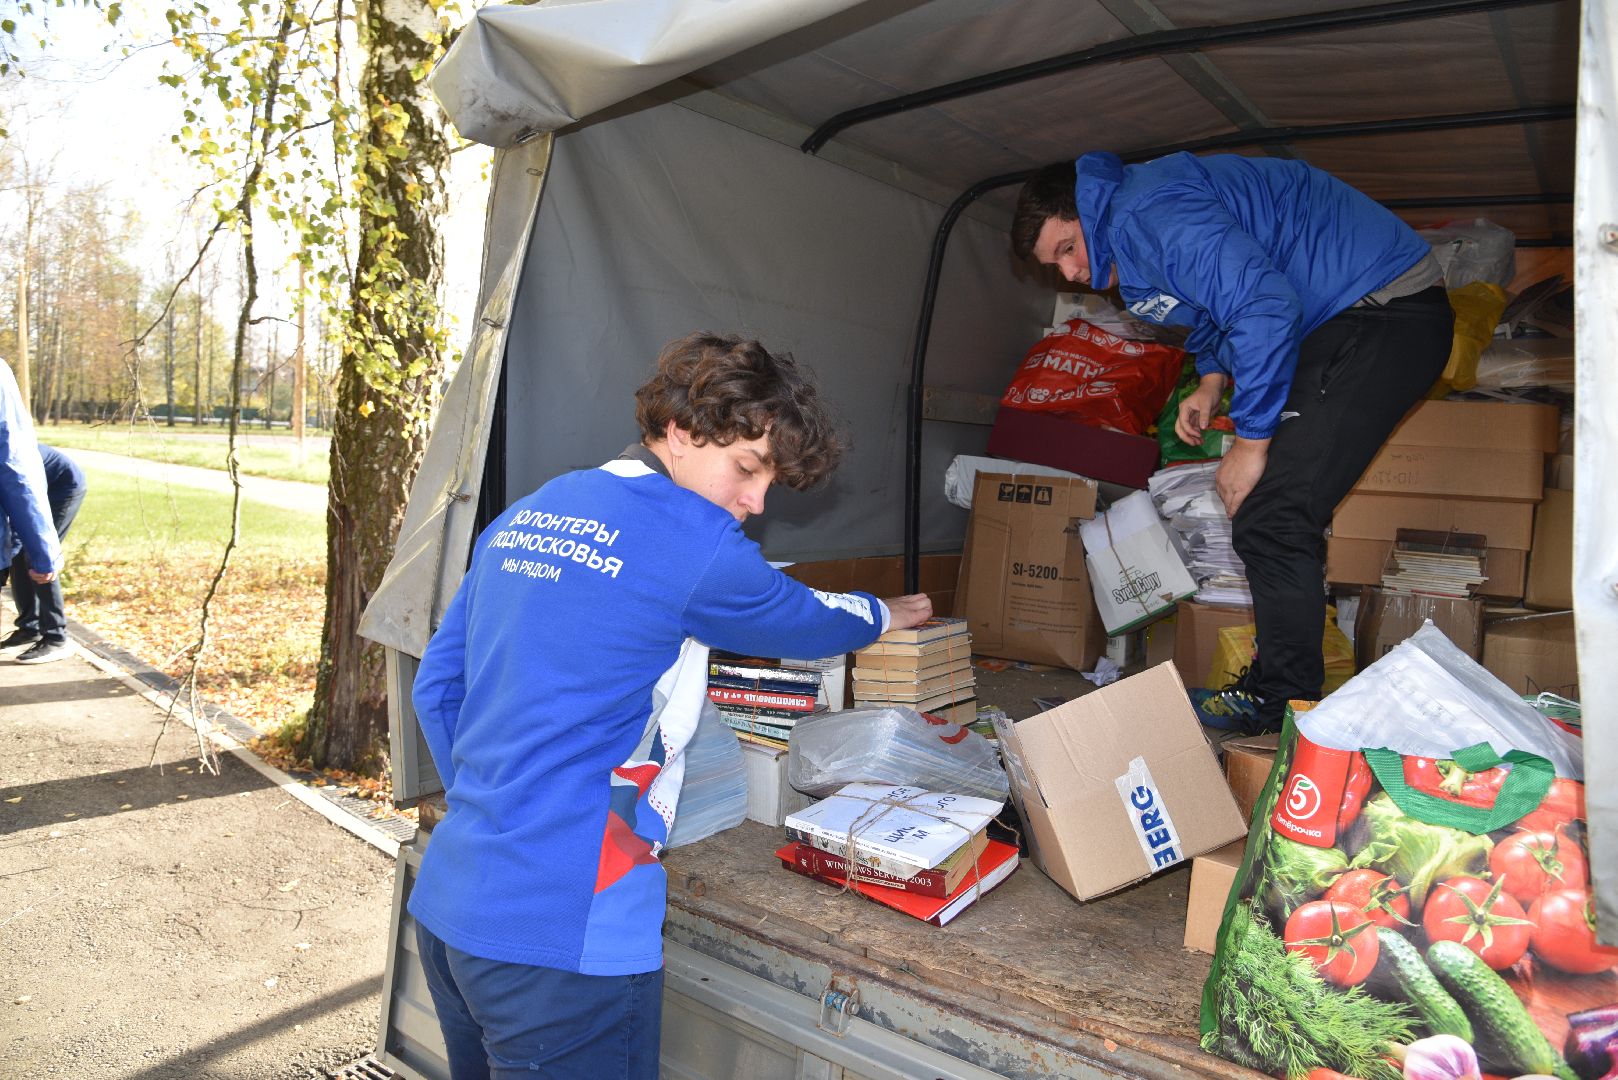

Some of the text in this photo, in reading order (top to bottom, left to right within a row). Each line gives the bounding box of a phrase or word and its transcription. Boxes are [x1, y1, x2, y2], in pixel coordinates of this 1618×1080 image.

[509, 509, 620, 547] ВОЛОНТЕРЫ
[487, 530, 624, 579] ПОДМОСКОВЬЯ
[501, 557, 562, 583] МЫ РЯДОМ
[1012, 562, 1058, 581] SI-5200
[1111, 572, 1162, 605] SvetoCopy
[1290, 779, 1313, 811] 5
[1275, 812, 1322, 838] Пятёрочка
[824, 859, 872, 876] WINDOWS
[910, 875, 932, 887] 2003
